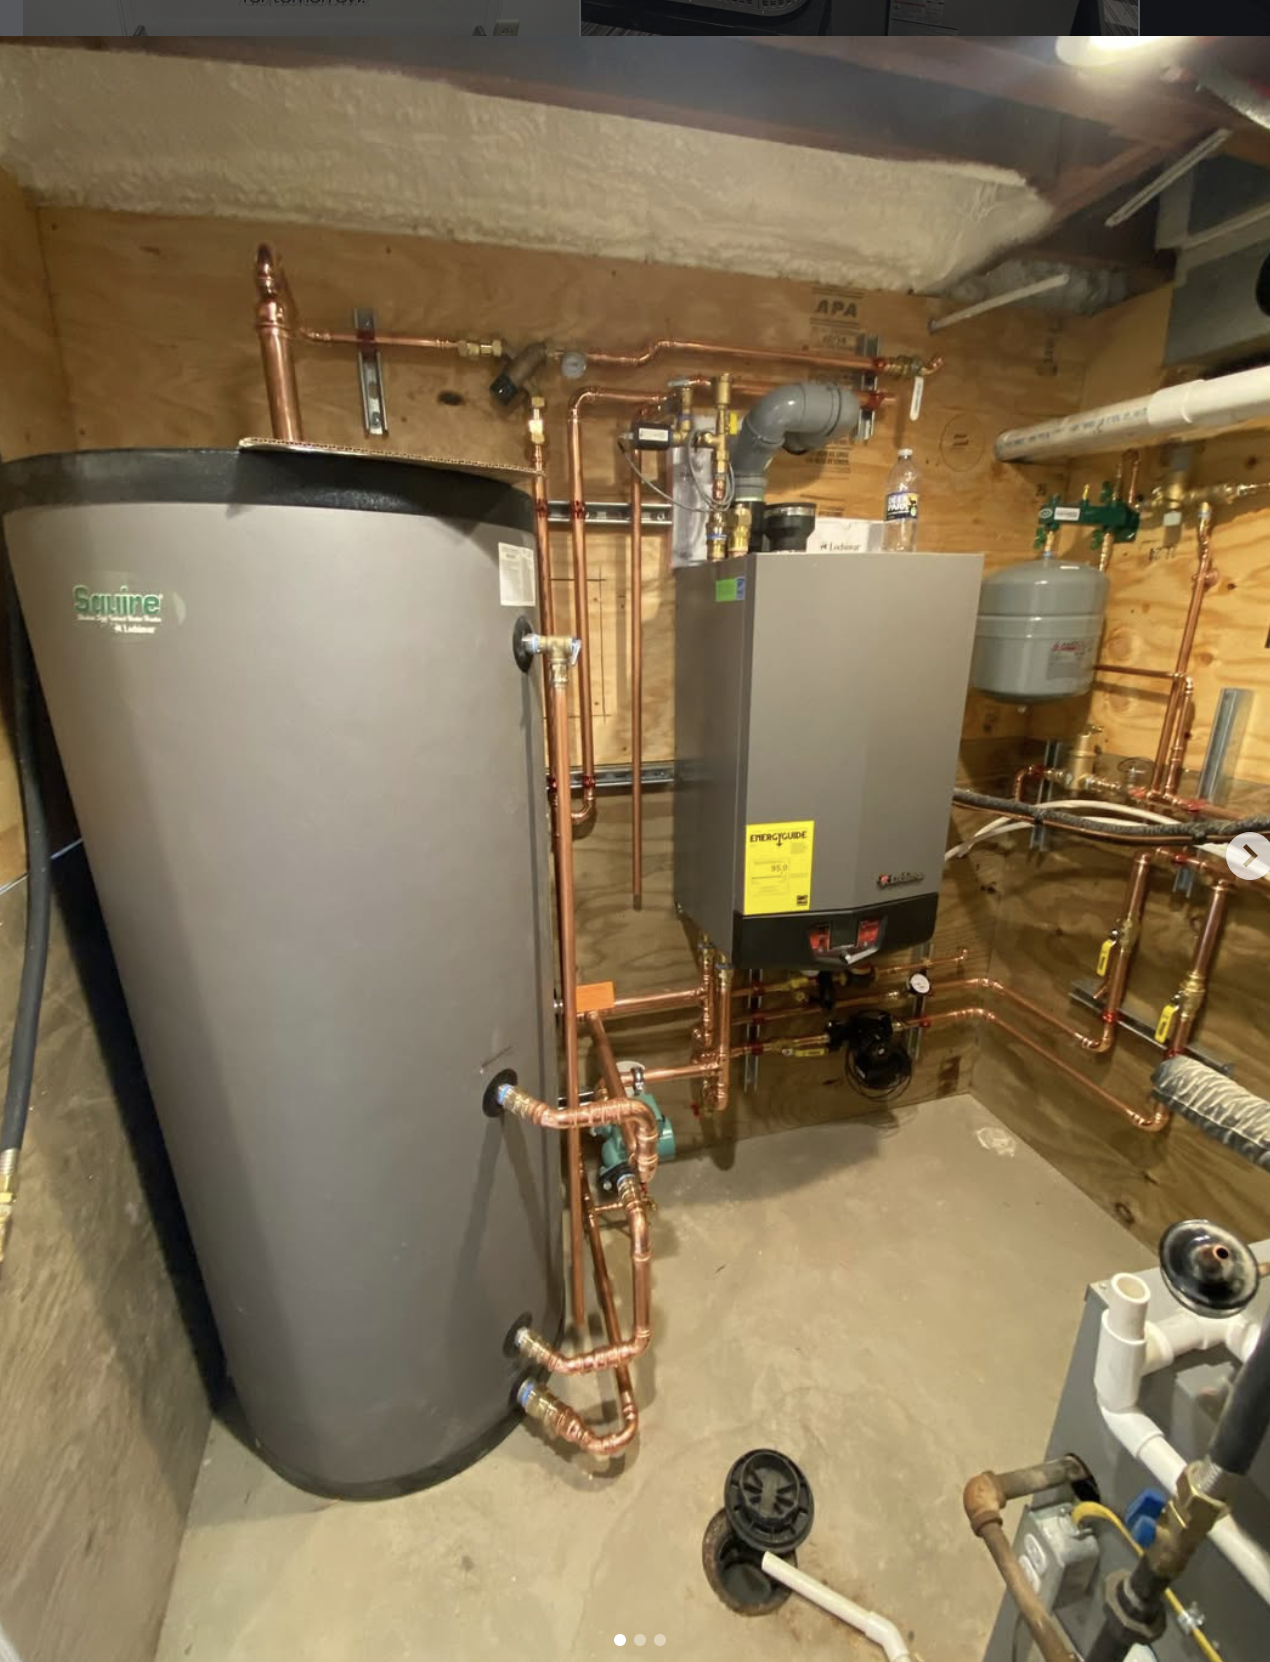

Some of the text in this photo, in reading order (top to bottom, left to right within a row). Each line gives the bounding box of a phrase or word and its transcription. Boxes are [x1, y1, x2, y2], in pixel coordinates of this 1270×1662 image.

[814, 299, 858, 318] APA
[73, 585, 161, 614] Squire
[749, 830, 808, 845] ENERGYGUIDE
